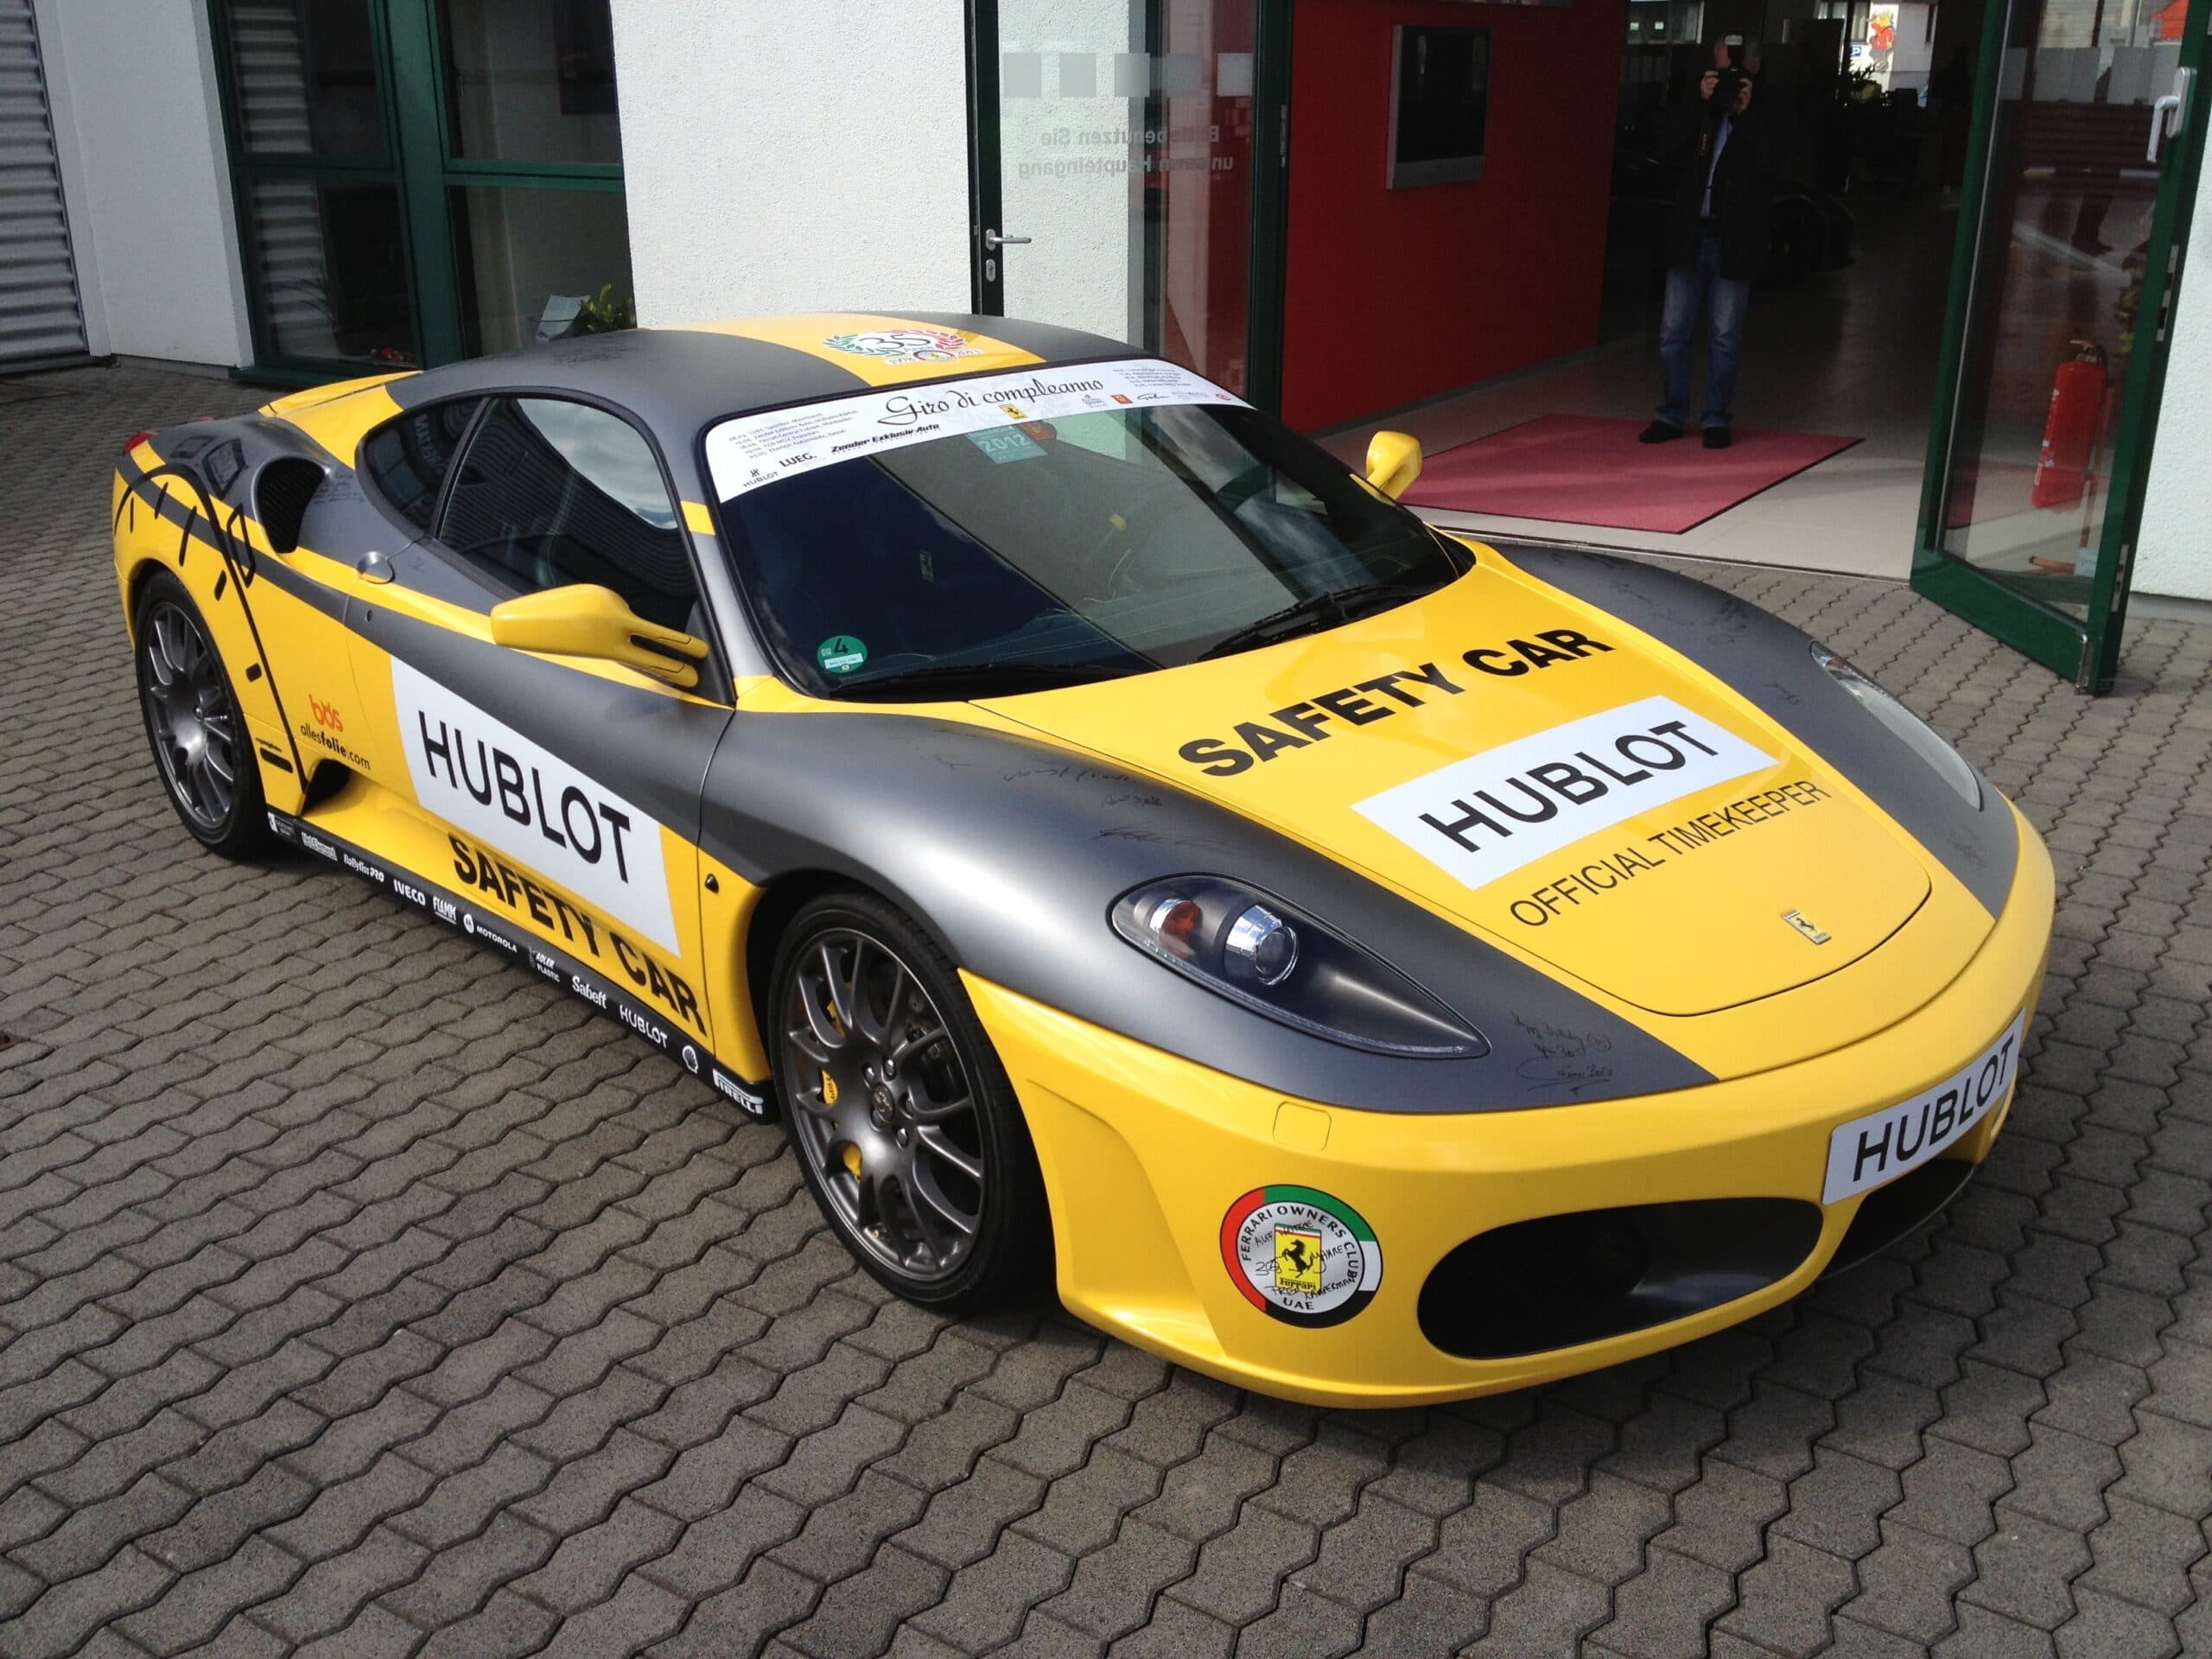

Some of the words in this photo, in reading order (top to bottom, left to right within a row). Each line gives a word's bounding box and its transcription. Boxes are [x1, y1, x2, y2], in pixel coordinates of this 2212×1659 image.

[859, 334, 931, 349] 35
[877, 396, 949, 426] Giro
[949, 391, 981, 409] di
[982, 379, 1104, 404] compleanno
[831, 437, 870, 453] Zender
[915, 423, 941, 434] Auto
[978, 435, 1031, 452] 2012
[743, 471, 779, 487] HUBLOT
[835, 638, 849, 653] 4
[1179, 663, 1465, 778] SAFETY
[1462, 628, 1617, 677] CAR
[418, 709, 631, 885] HUBLOT
[1418, 720, 1720, 853] HUBLOT
[1509, 836, 1667, 927] OFFICIAL
[1647, 779, 1833, 856] TIMEKEEPER
[393, 879, 426, 906] IVECO
[432, 896, 457, 921] FIAMM
[448, 831, 601, 959] SAFETY
[609, 931, 709, 1037] CAR
[476, 925, 518, 952] MOTOROLA
[572, 976, 607, 1009] Sabelt
[620, 1004, 668, 1048] HUBLOT
[712, 1068, 763, 1115] PIRELLI
[1853, 1033, 2014, 1182] HUBLOT
[1241, 1209, 1273, 1262] FERRARI
[1277, 1205, 1346, 1238] OWNERS
[1344, 1242, 1359, 1279] CLUB
[1280, 1278, 1317, 1291] Ferrari
[1283, 1297, 1314, 1311] UAE
